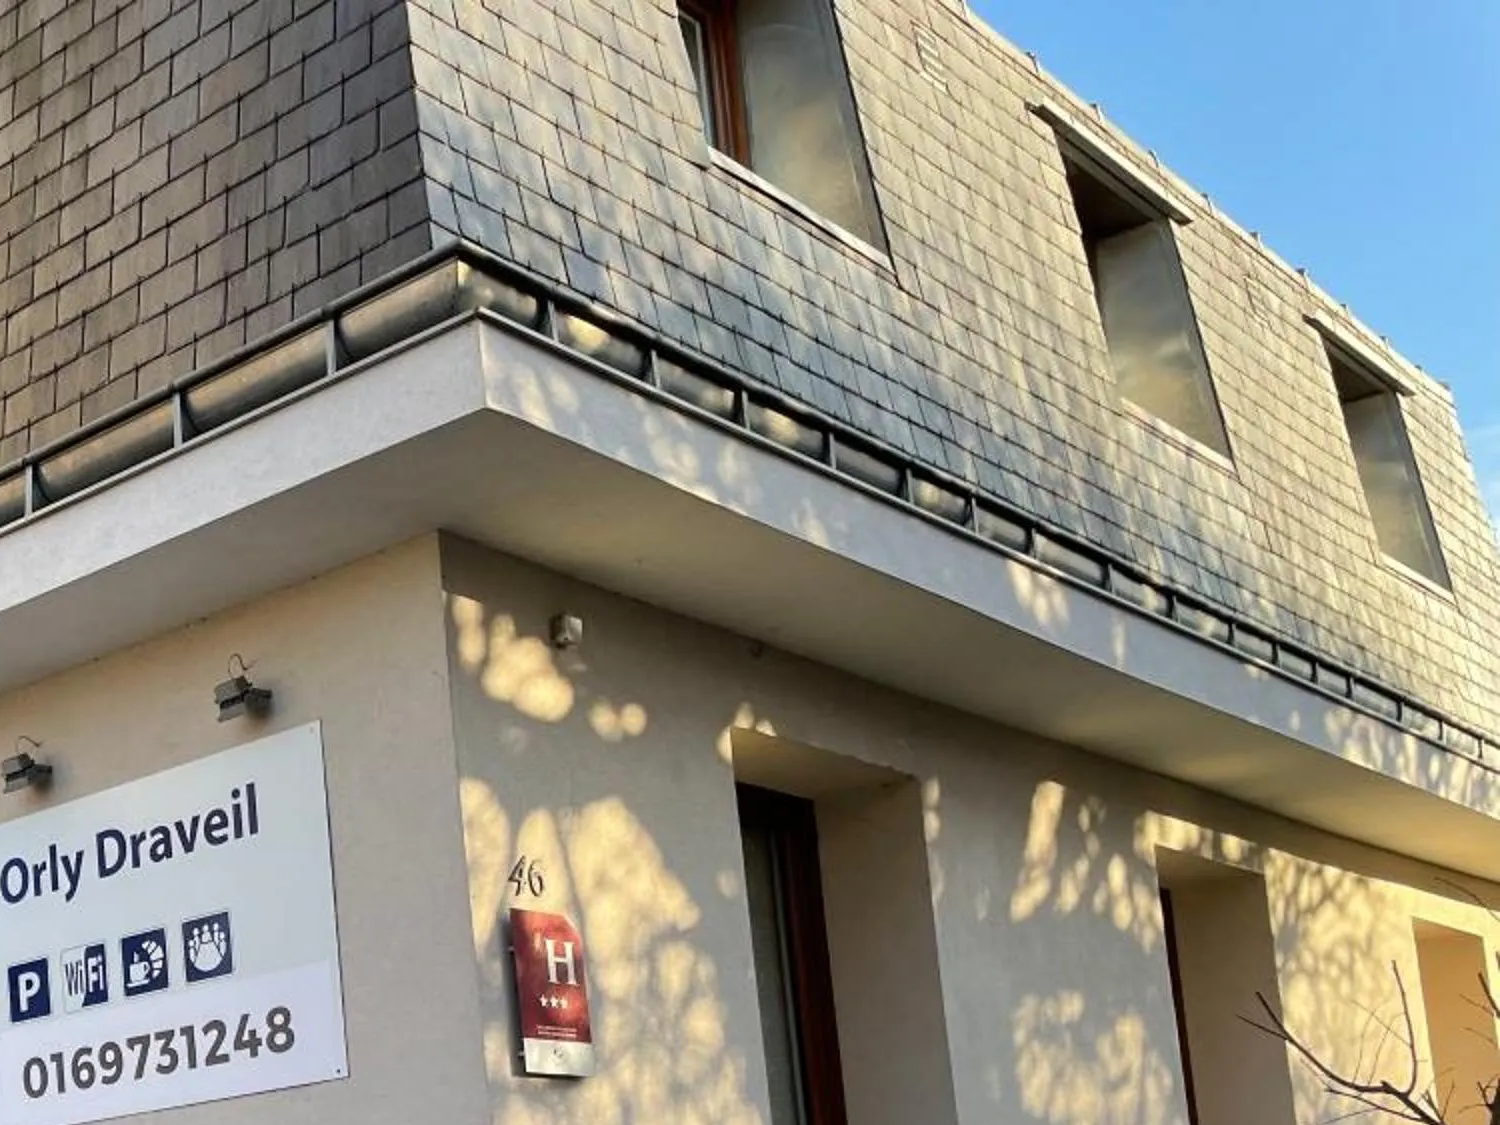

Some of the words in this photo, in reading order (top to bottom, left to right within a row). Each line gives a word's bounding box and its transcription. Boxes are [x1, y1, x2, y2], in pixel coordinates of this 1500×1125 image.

[0, 843, 85, 904] Orly
[95, 782, 259, 879] Draveil
[508, 855, 545, 897] 46
[544, 938, 577, 985] H
[18, 971, 41, 1013] P
[22, 1005, 296, 1099] 0169731248
